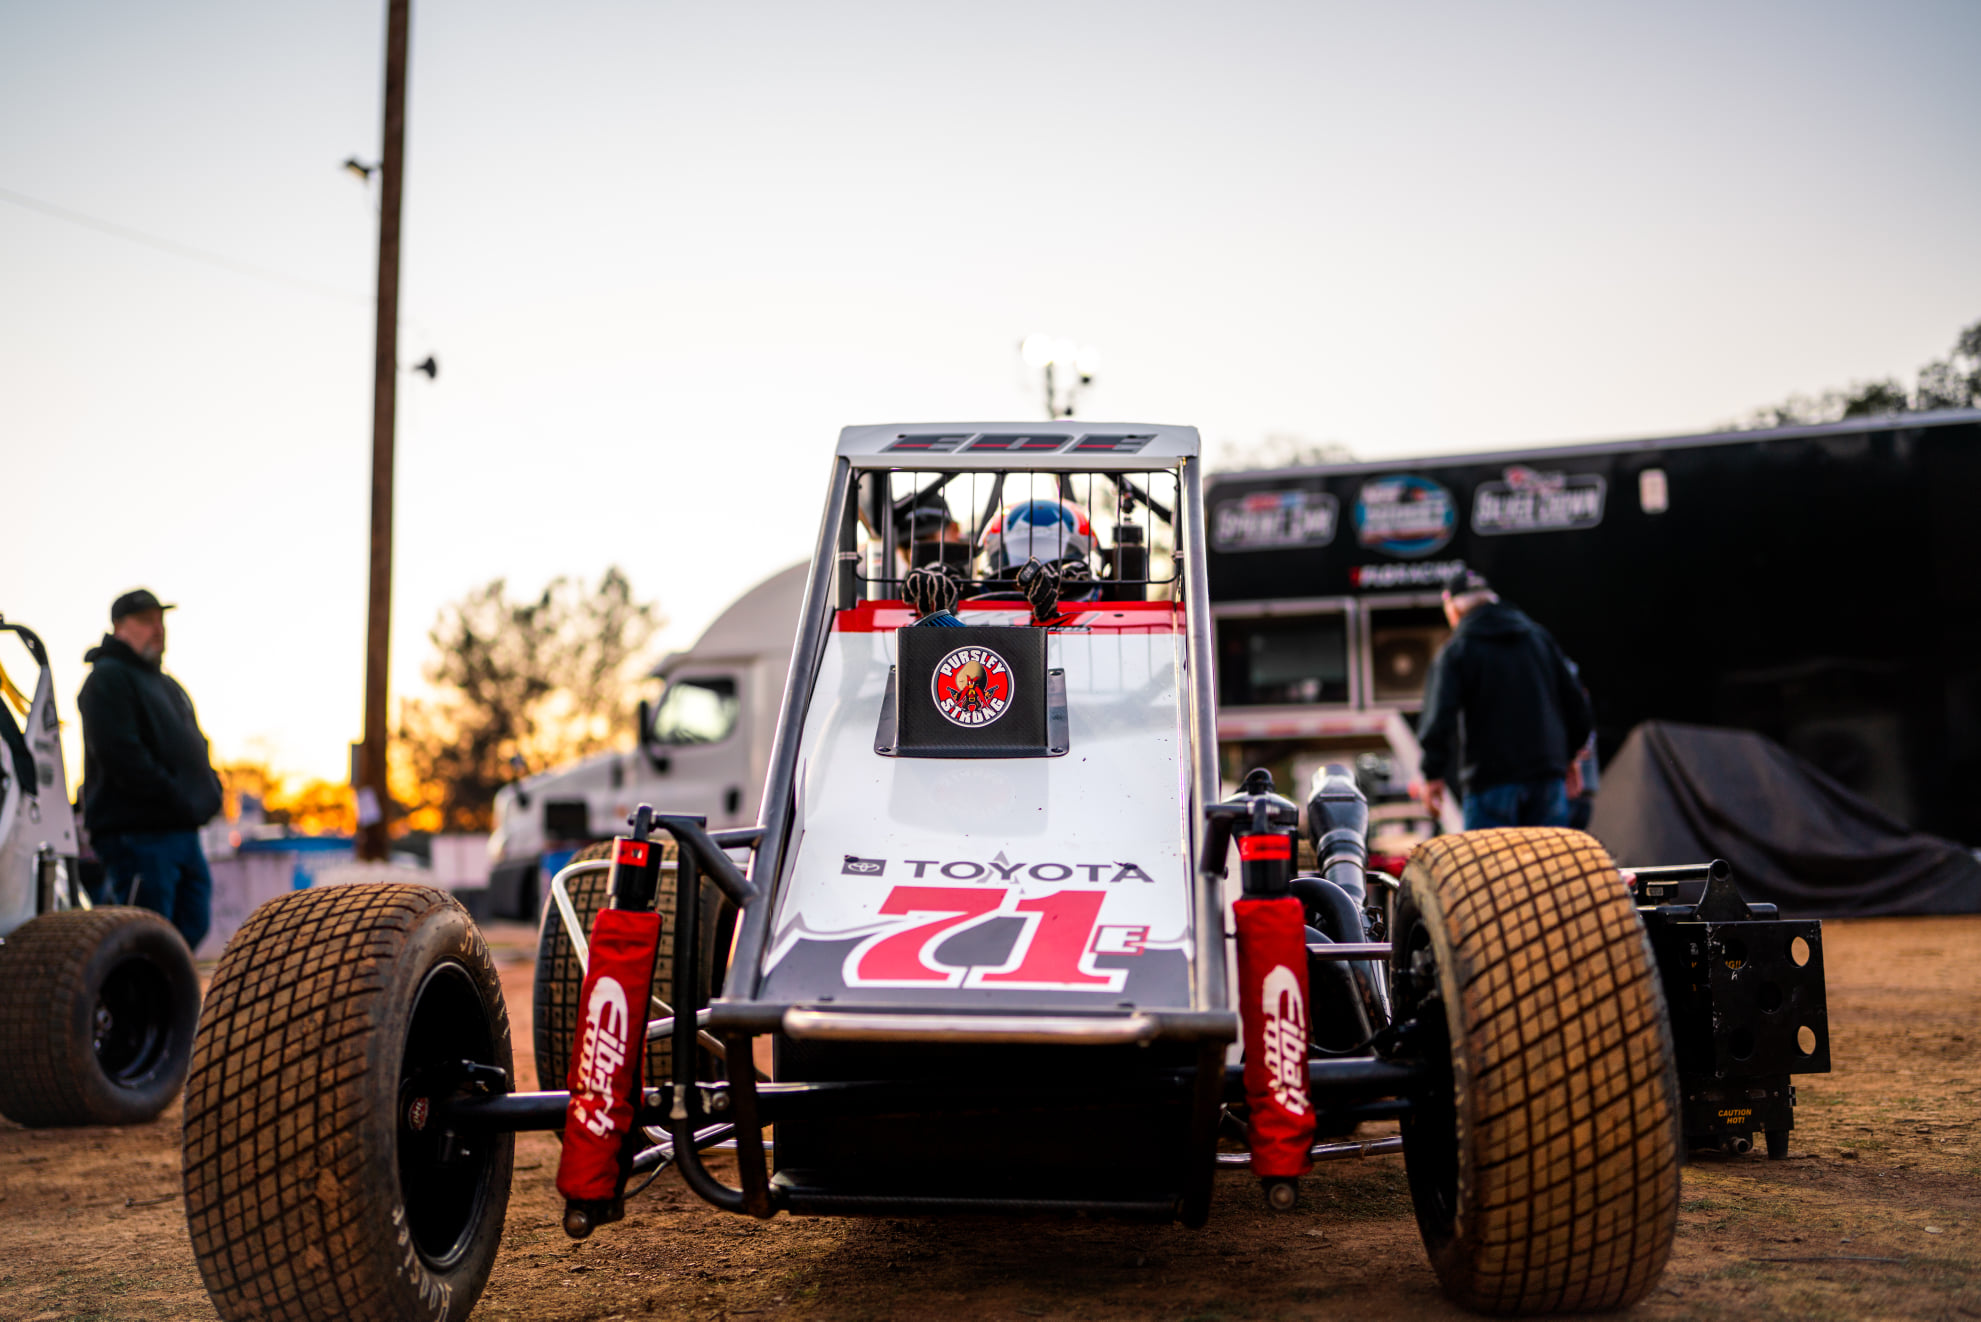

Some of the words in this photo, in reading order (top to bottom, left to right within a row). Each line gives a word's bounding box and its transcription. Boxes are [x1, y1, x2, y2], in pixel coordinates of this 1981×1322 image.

[940, 650, 1006, 677] PURSLEY
[940, 698, 1005, 723] STRONG
[904, 860, 1155, 883] TOYOTA
[1718, 1108, 1752, 1117] CAUTION
[1726, 1116, 1745, 1125] HOT!
